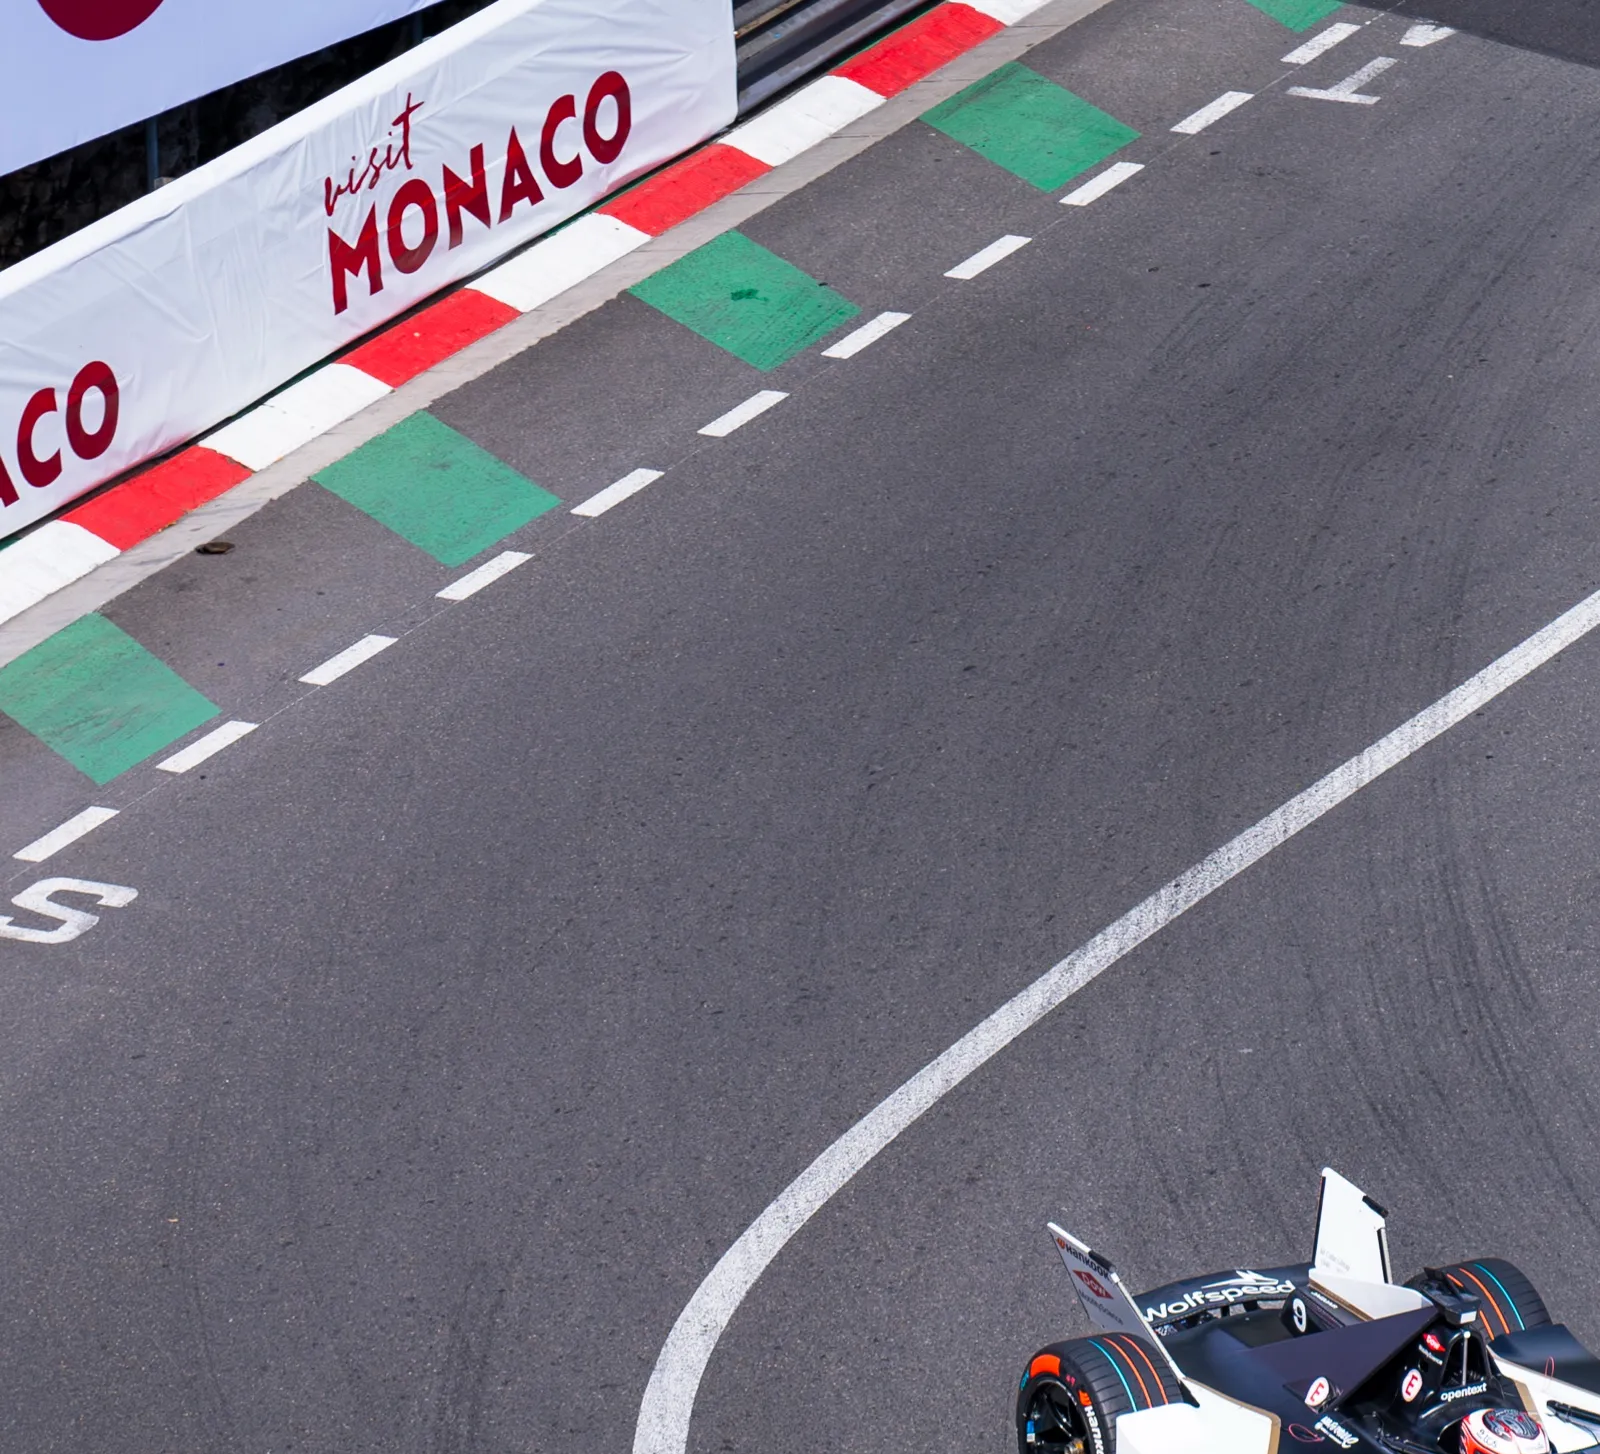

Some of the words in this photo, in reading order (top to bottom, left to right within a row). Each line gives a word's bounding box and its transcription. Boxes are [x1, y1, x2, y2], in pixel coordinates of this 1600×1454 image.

[325, 92, 424, 217] visit
[327, 70, 632, 316] MONACO
[1144, 1279, 1296, 1322] Wolfspeed
[1292, 1298, 1306, 1332] 9
[1440, 1382, 1487, 1402] opentext
